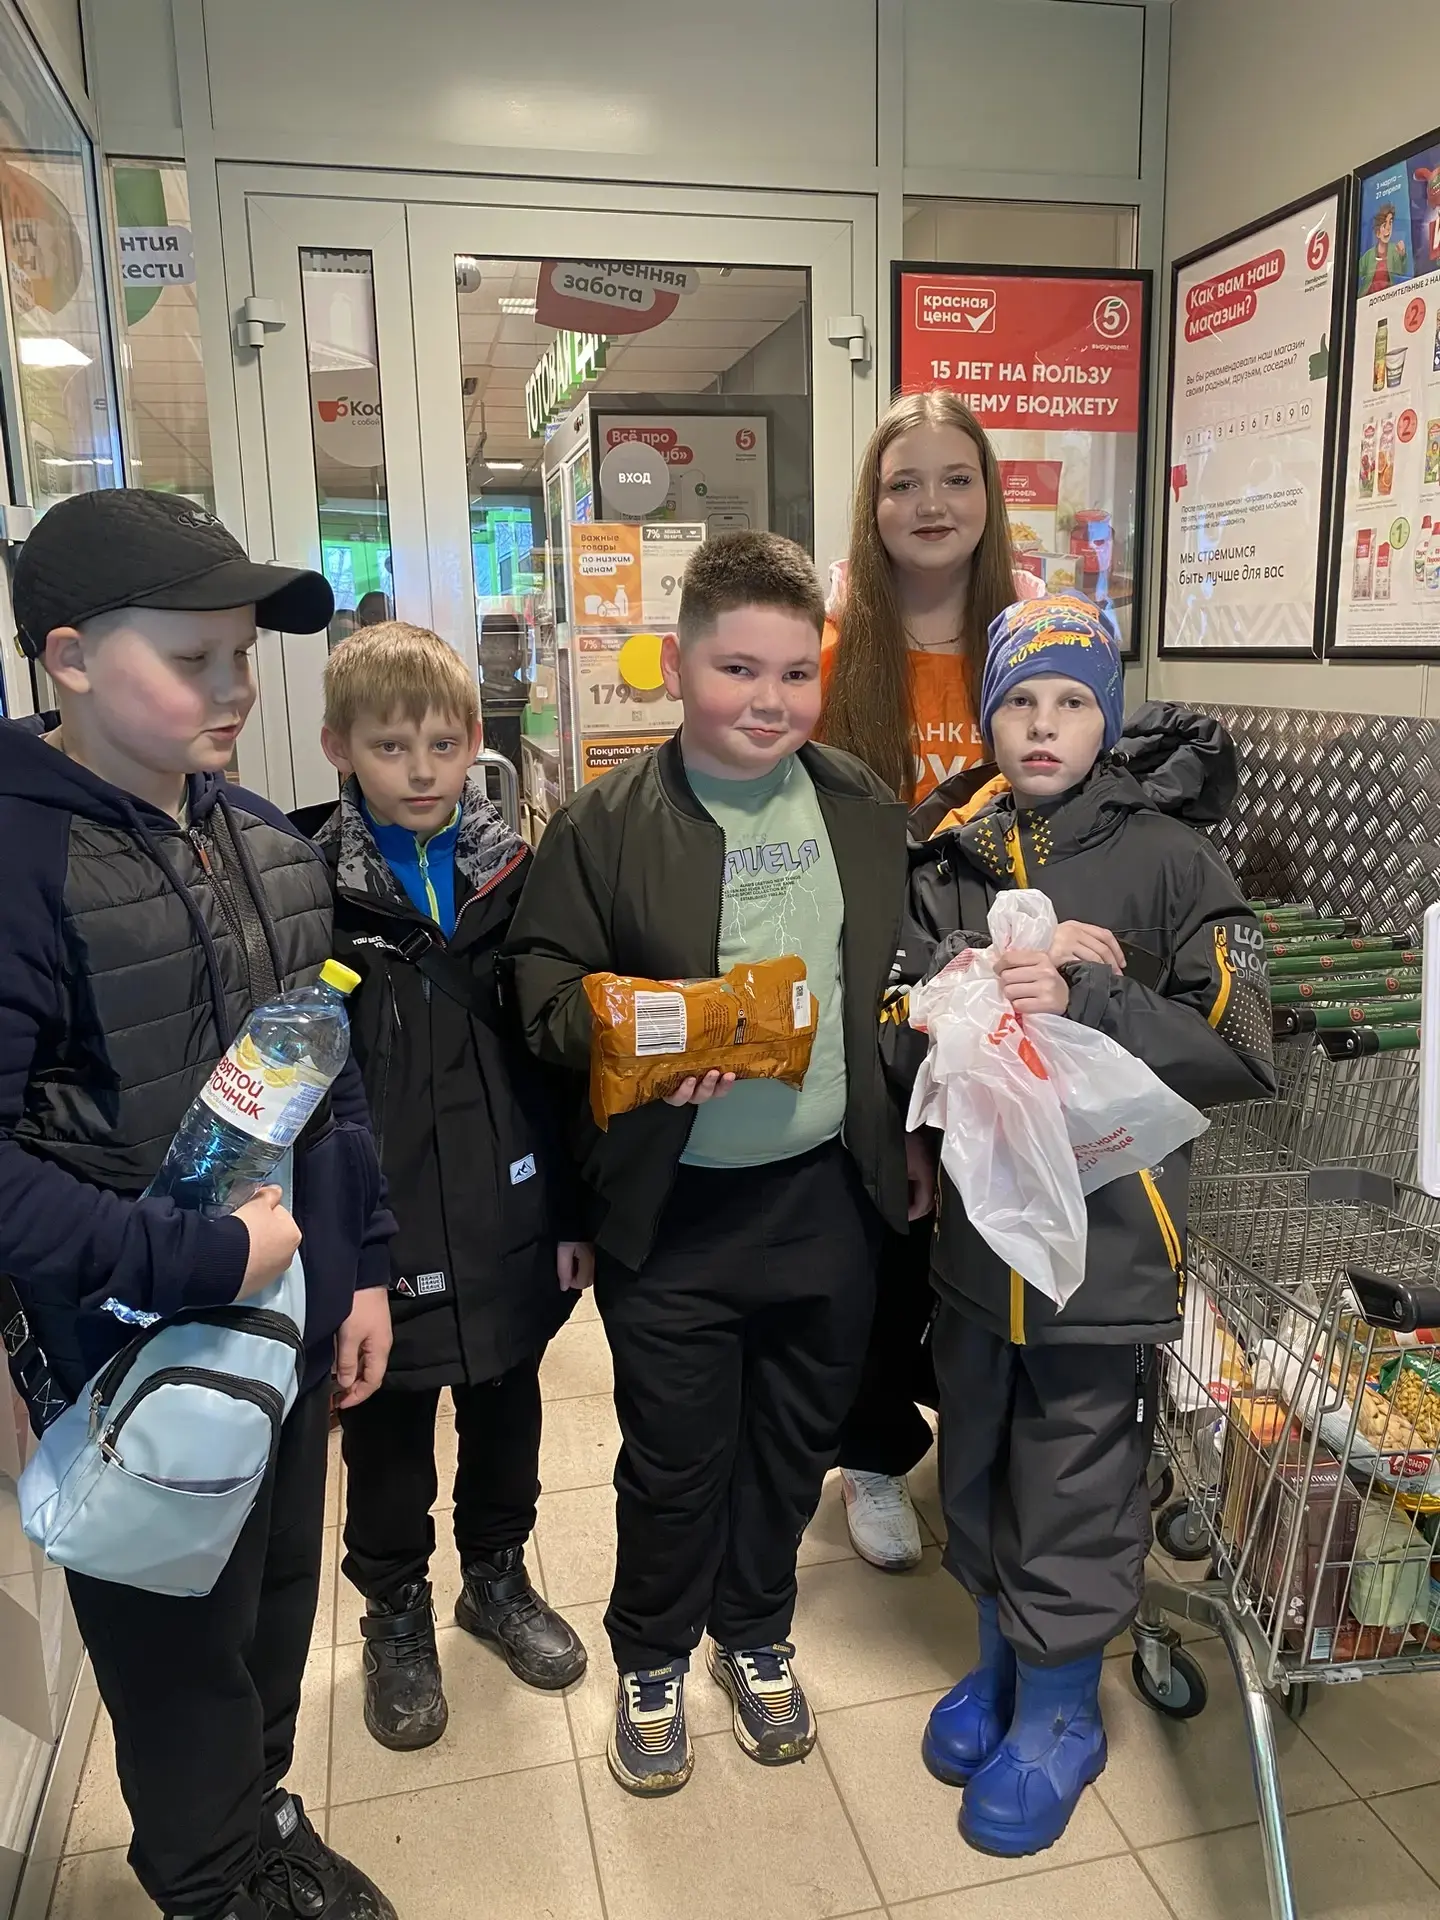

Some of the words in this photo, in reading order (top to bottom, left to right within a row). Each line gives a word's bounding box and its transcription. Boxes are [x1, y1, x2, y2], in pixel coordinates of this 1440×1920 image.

[120, 235, 179, 252] нтия
[564, 275, 643, 303] забота
[1190, 284, 1214, 309] Как
[1217, 273, 1244, 298] вам
[1247, 257, 1279, 285] наш
[923, 295, 988, 309] красная
[1369, 281, 1424, 307] ДОПОЛНИТЕЛЬНЫЕ
[923, 309, 961, 324] цена
[1189, 294, 1252, 336] магазин?
[1409, 305, 1418, 327] 2
[1092, 343, 1129, 351] выручает!
[1186, 375, 1195, 385] Вы
[1195, 371, 1204, 382] бы
[1205, 356, 1257, 382] рекомендовали
[1257, 350, 1273, 361] наш
[1273, 339, 1306, 356] магазин
[1263, 353, 1298, 373] соседям?
[931, 360, 950, 379] 15
[956, 361, 993, 380] ЛЕТ
[999, 363, 1027, 382] НА
[1033, 365, 1112, 385] ПОЛЬЗУ
[956, 393, 1011, 412] ШЕМУ
[1016, 395, 1118, 417] БЮДЖЕТУ
[1301, 404, 1310, 416] 10
[357, 418, 380, 426] собой
[1402, 415, 1410, 436] 2
[612, 430, 638, 443] Всё
[642, 433, 669, 446] про
[661, 450, 688, 463] уб»
[618, 472, 651, 485] ВХОД
[1286, 487, 1303, 498] опрос
[581, 534, 619, 542] Важные
[646, 529, 661, 539] 7%
[581, 544, 616, 552] товары
[1180, 552, 1195, 564] мы
[1197, 545, 1256, 565] стремимся
[582, 566, 613, 574] ценам
[1179, 569, 1203, 585] быть
[1206, 568, 1239, 586] лучше
[1242, 564, 1260, 581] для
[1264, 565, 1284, 578] вас
[583, 640, 598, 649] 7%
[589, 684, 632, 704] 179
[909, 722, 963, 743] АНК
[589, 746, 641, 757] Покупайте
[209, 1070, 265, 1120] ТОЧНИК
